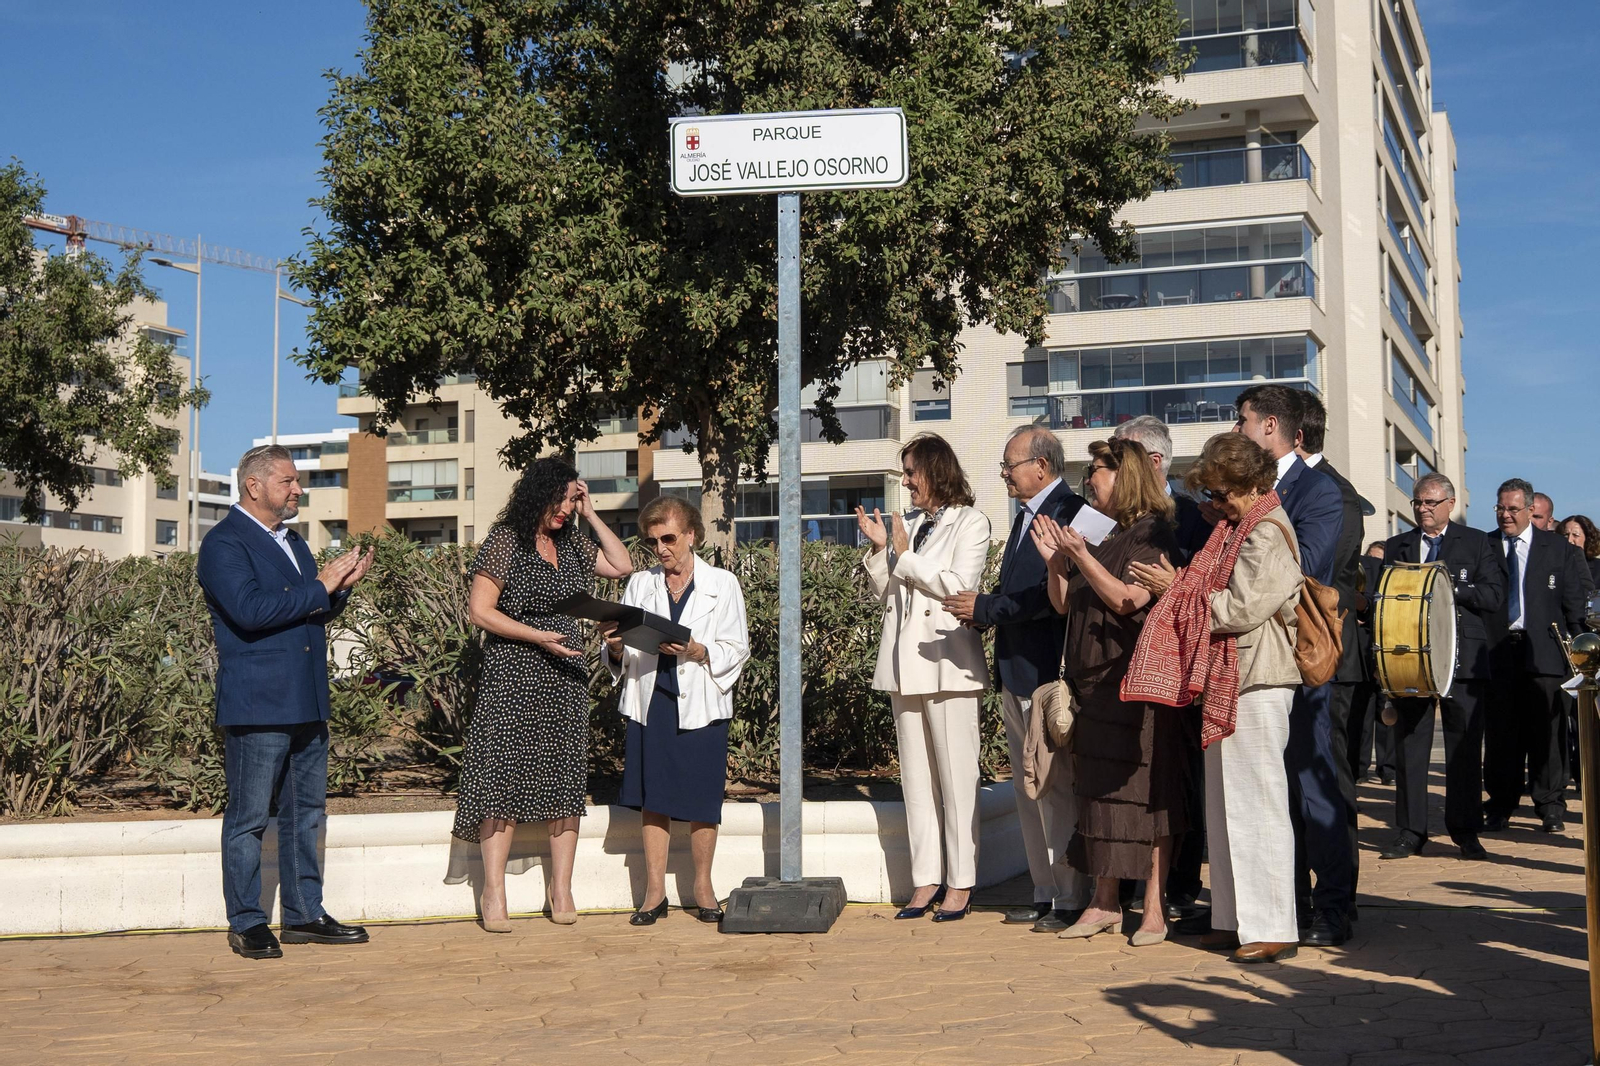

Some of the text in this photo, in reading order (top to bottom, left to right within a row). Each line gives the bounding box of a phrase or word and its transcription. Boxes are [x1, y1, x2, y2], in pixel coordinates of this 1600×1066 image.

[753, 125, 822, 141] PARQUE
[680, 151, 707, 159] ALMERÍA
[688, 155, 888, 183] JOSÉ VALLEJO OSORNO
